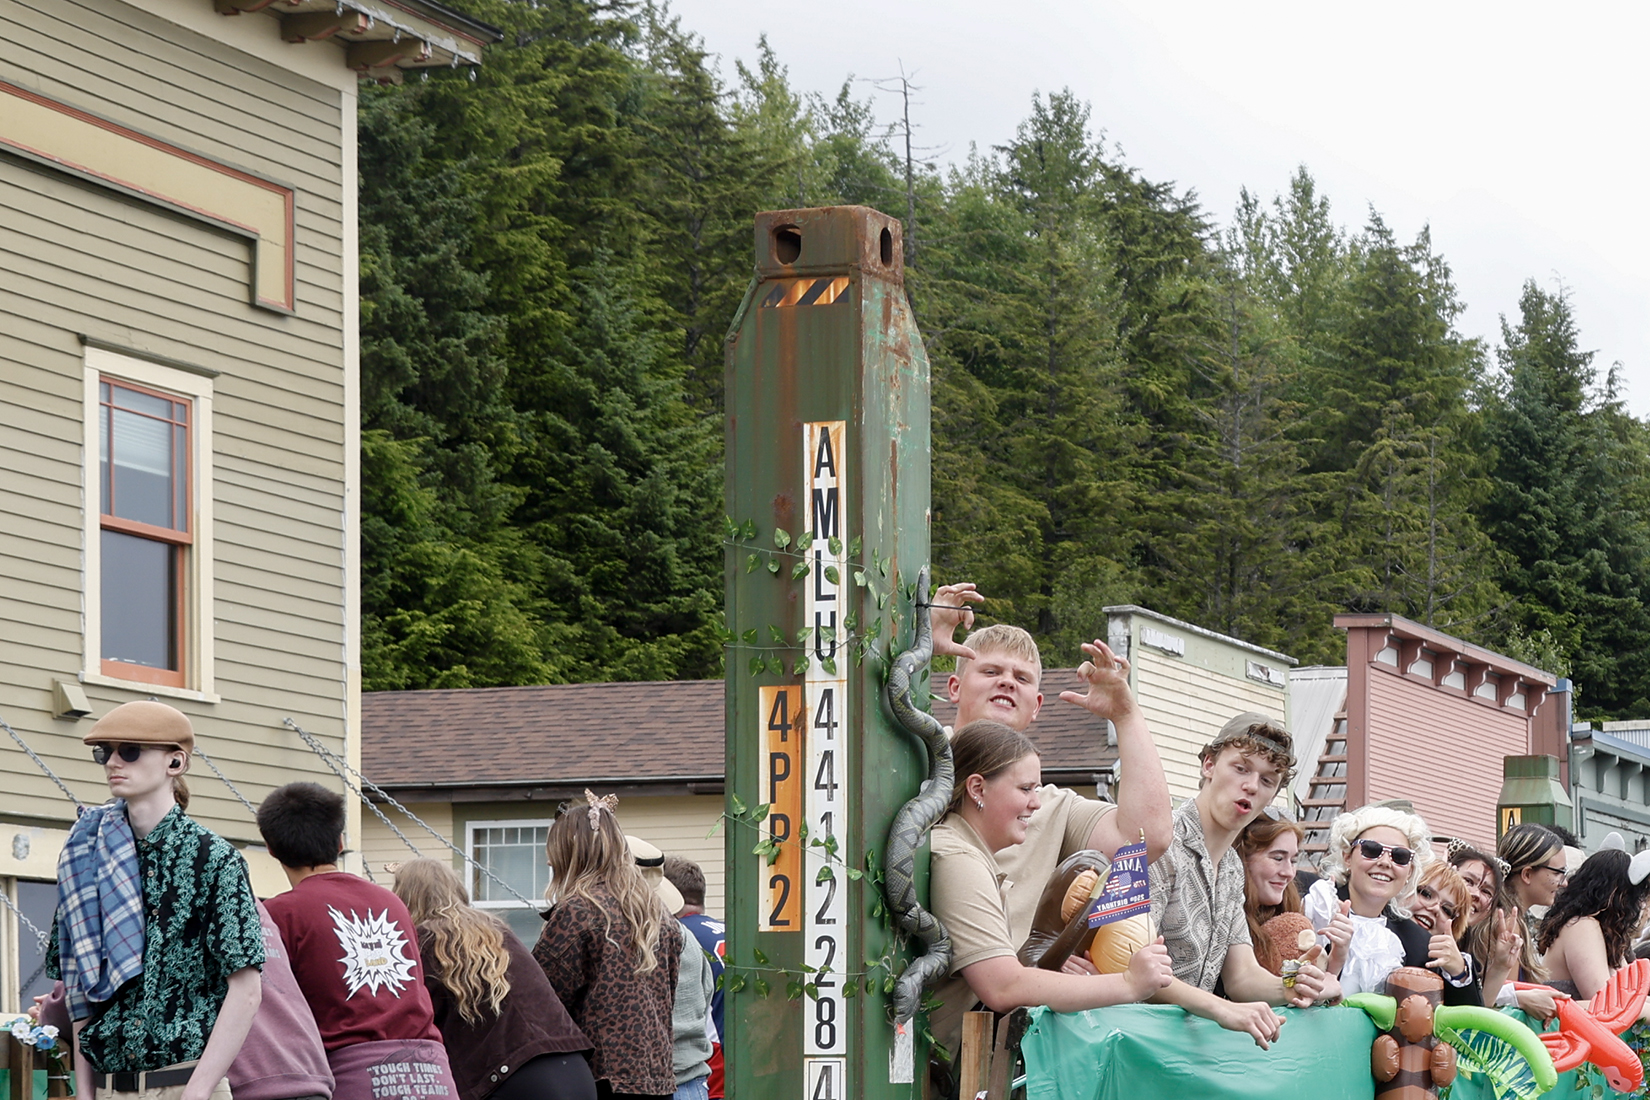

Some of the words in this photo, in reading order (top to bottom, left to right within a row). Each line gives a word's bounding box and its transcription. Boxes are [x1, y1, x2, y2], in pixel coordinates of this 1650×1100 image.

[812, 425, 838, 661] AMLU
[413, 1062, 443, 1075] TIMES
[371, 1073, 406, 1087] DON'T
[408, 1073, 440, 1084] LAST.
[372, 1084, 412, 1099] TOUGH
[413, 1084, 449, 1096] TEAMS
